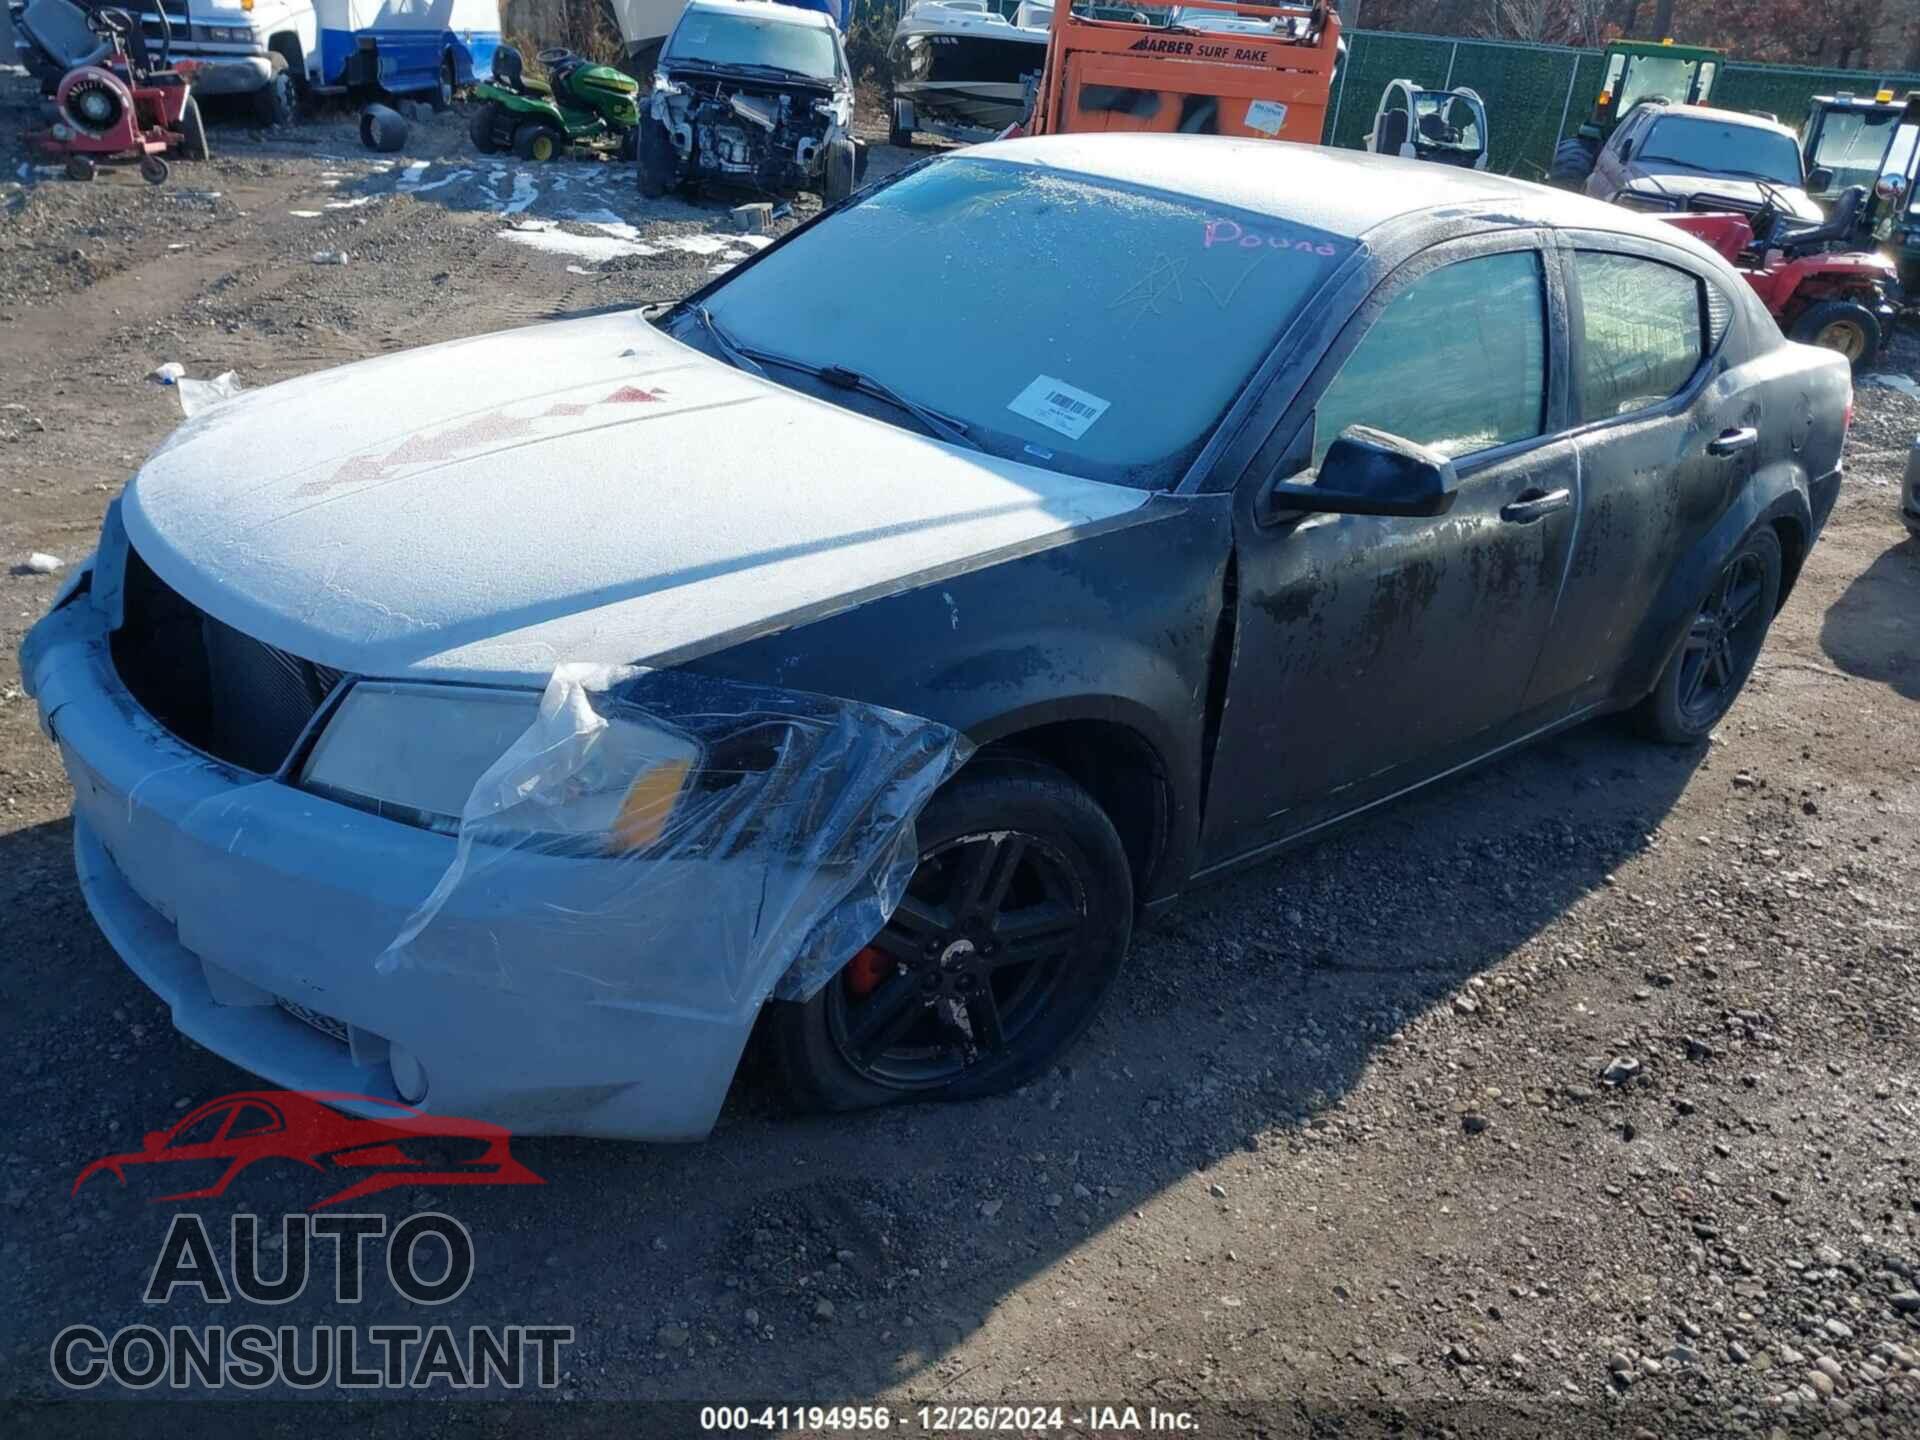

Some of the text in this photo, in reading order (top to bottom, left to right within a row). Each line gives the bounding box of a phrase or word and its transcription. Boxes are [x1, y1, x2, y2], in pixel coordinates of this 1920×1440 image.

[1128, 36, 1268, 62] BARBER SURF RAKE
